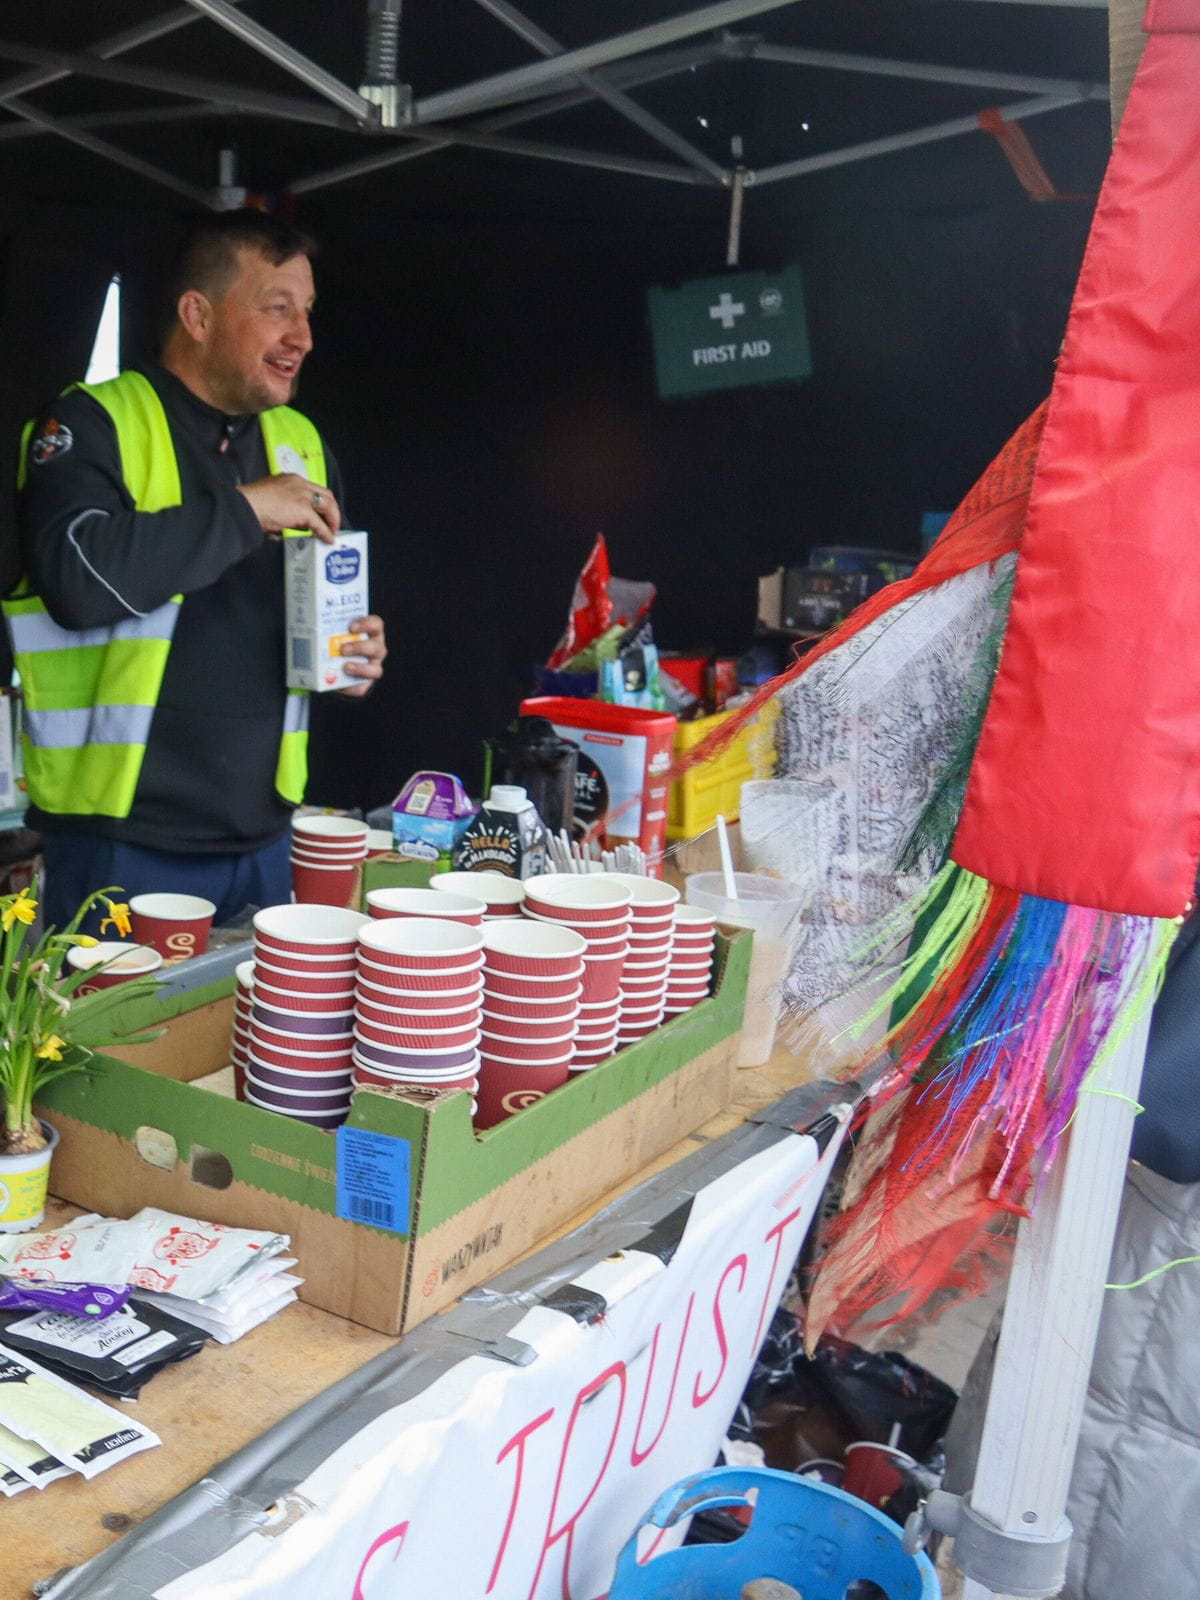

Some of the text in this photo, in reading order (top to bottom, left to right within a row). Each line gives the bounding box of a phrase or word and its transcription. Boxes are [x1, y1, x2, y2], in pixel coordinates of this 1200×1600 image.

[692, 339, 772, 366] FIRST AID
[470, 836, 511, 849] HELLO
[485, 1206, 801, 1600] TRUST
